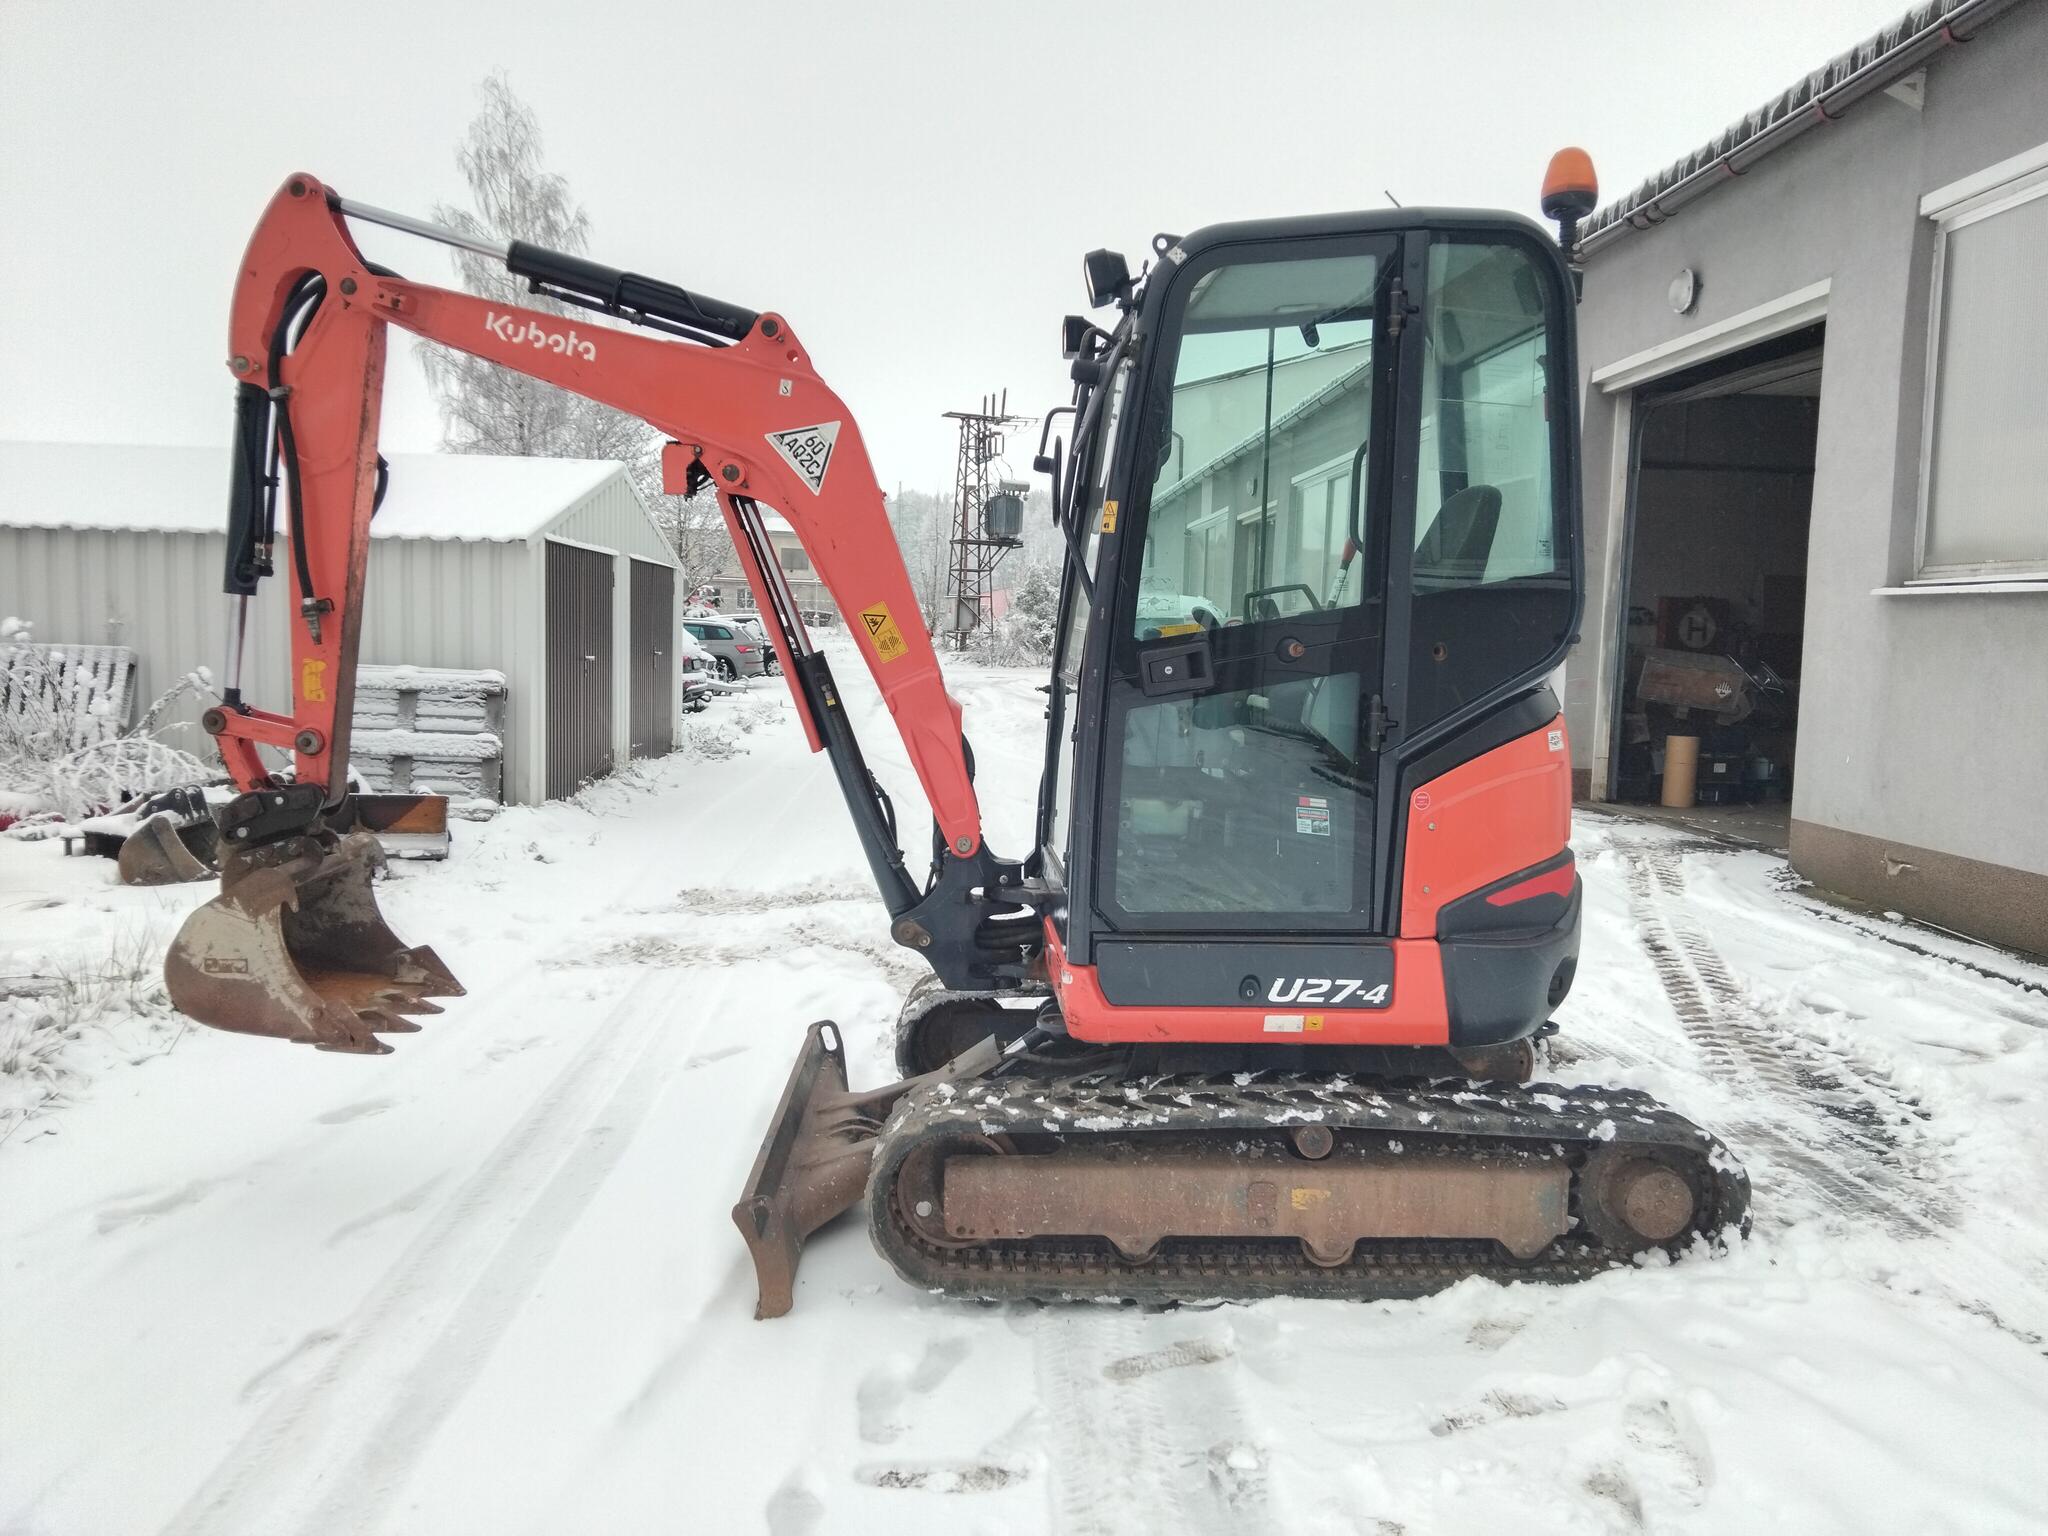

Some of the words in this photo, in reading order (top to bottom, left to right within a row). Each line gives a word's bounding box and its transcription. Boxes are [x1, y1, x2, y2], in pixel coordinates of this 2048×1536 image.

[485, 311, 597, 362] Kubota
[784, 437, 821, 475] AQ2C
[1267, 977, 1390, 1004] U27-4
